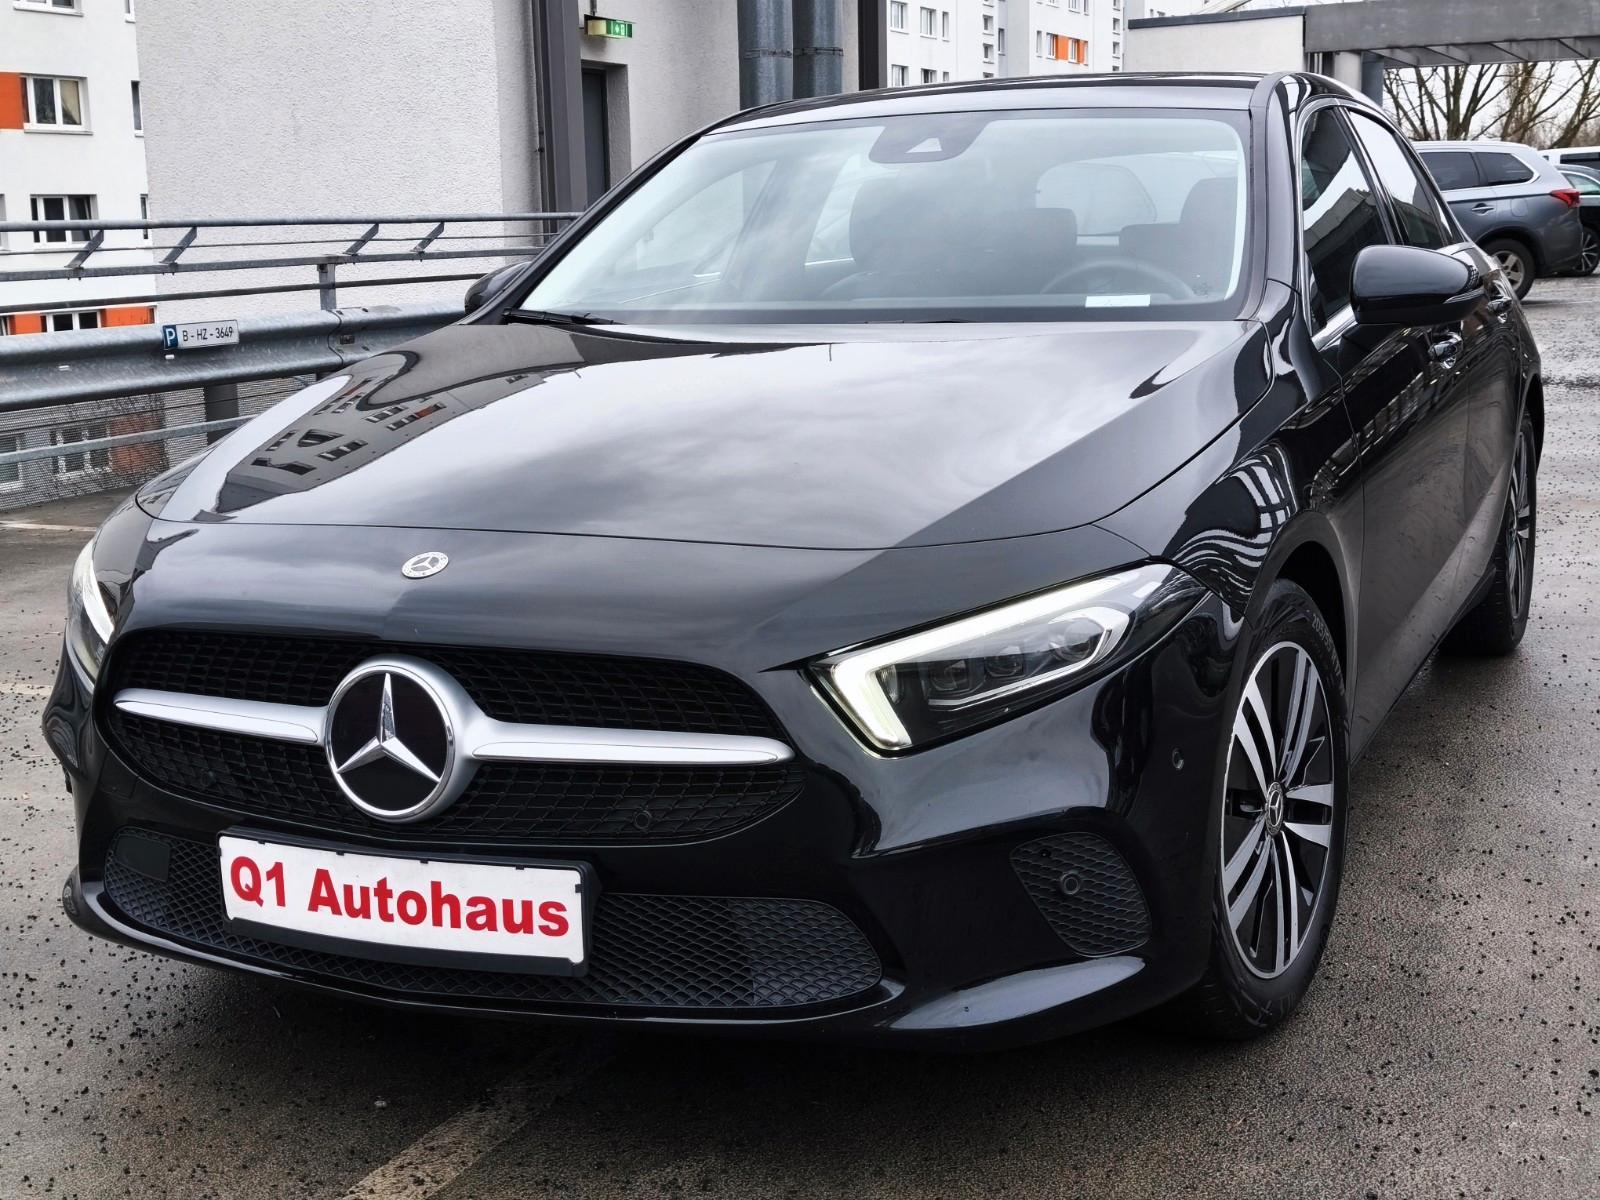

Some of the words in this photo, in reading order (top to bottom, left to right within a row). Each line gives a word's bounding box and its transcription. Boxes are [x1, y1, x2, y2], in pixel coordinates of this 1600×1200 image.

[165, 328, 175, 347] P
[230, 855, 287, 908] Q1
[307, 868, 570, 938] Autohaus
